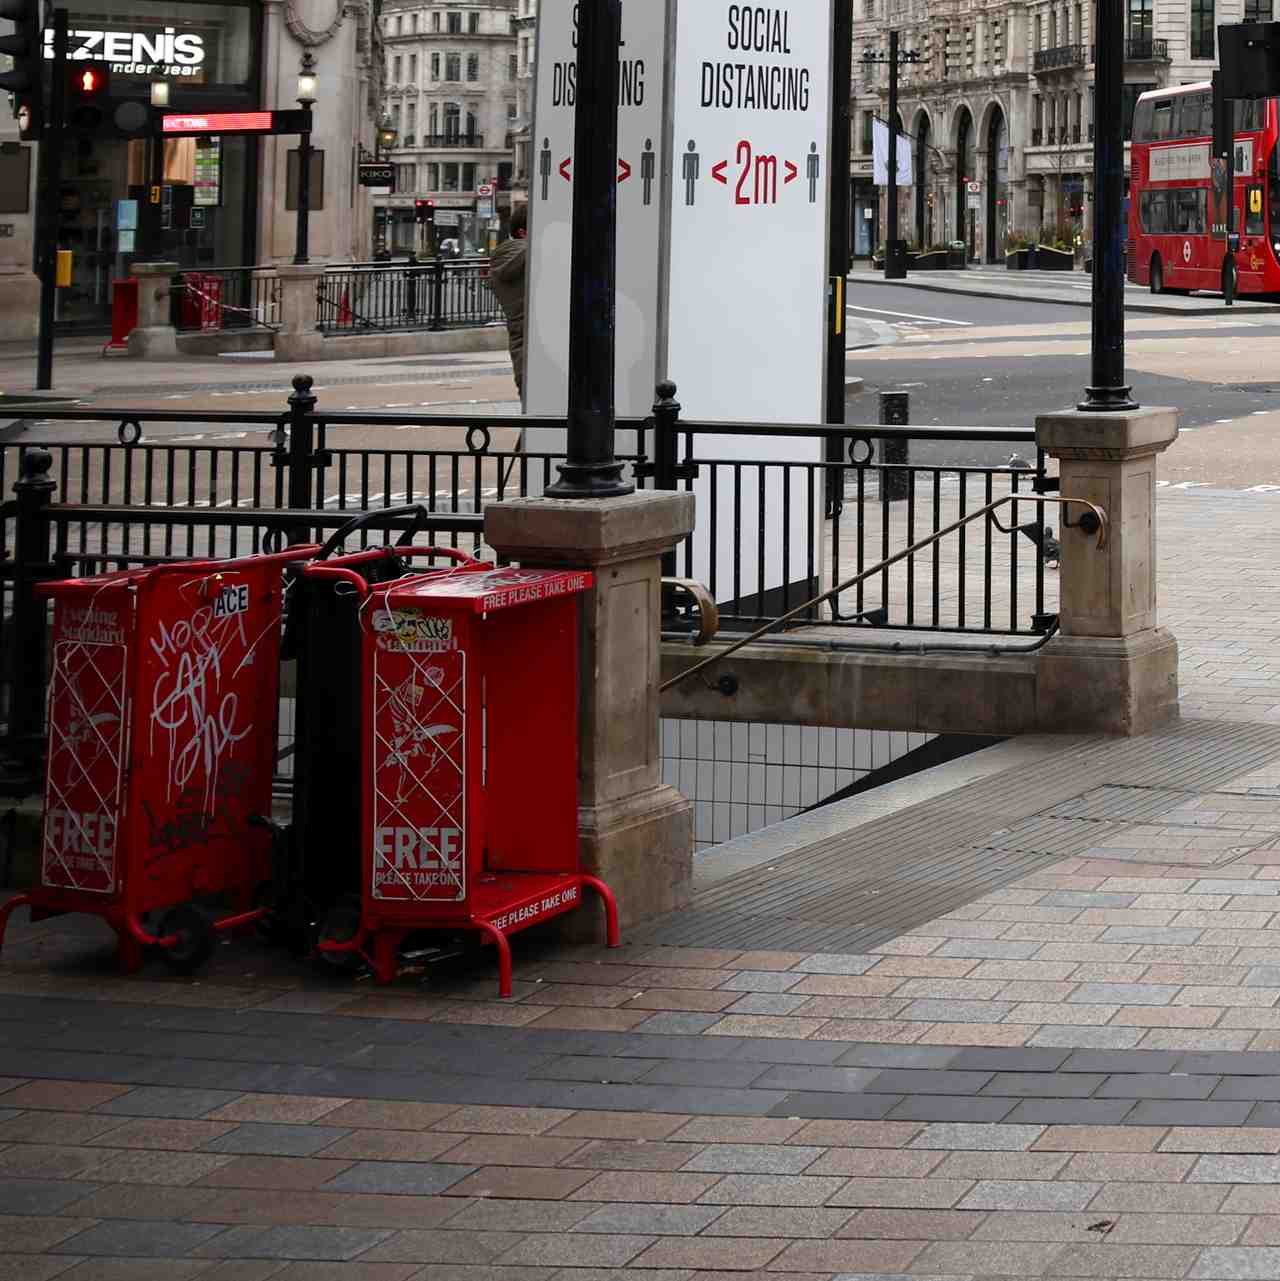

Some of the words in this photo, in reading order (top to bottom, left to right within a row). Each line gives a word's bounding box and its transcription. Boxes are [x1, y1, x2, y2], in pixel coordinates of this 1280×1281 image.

[728, 4, 791, 54] SOCIAL
[700, 61, 809, 112] DISTANCING
[735, 140, 778, 205] 2m
[483, 595, 508, 611] FREE
[508, 589, 543, 606] PLEASE
[544, 581, 566, 599] TAKE
[567, 575, 586, 592] ONE
[47, 810, 113, 857] FREE
[375, 827, 460, 869] FREE
[376, 872, 412, 885] PLEASE
[414, 872, 437, 886] TAKE
[439, 872, 461, 885] ONE
[508, 904, 540, 926] PLEASE
[541, 896, 561, 915] TAKE
[561, 886, 577, 904] ONE
